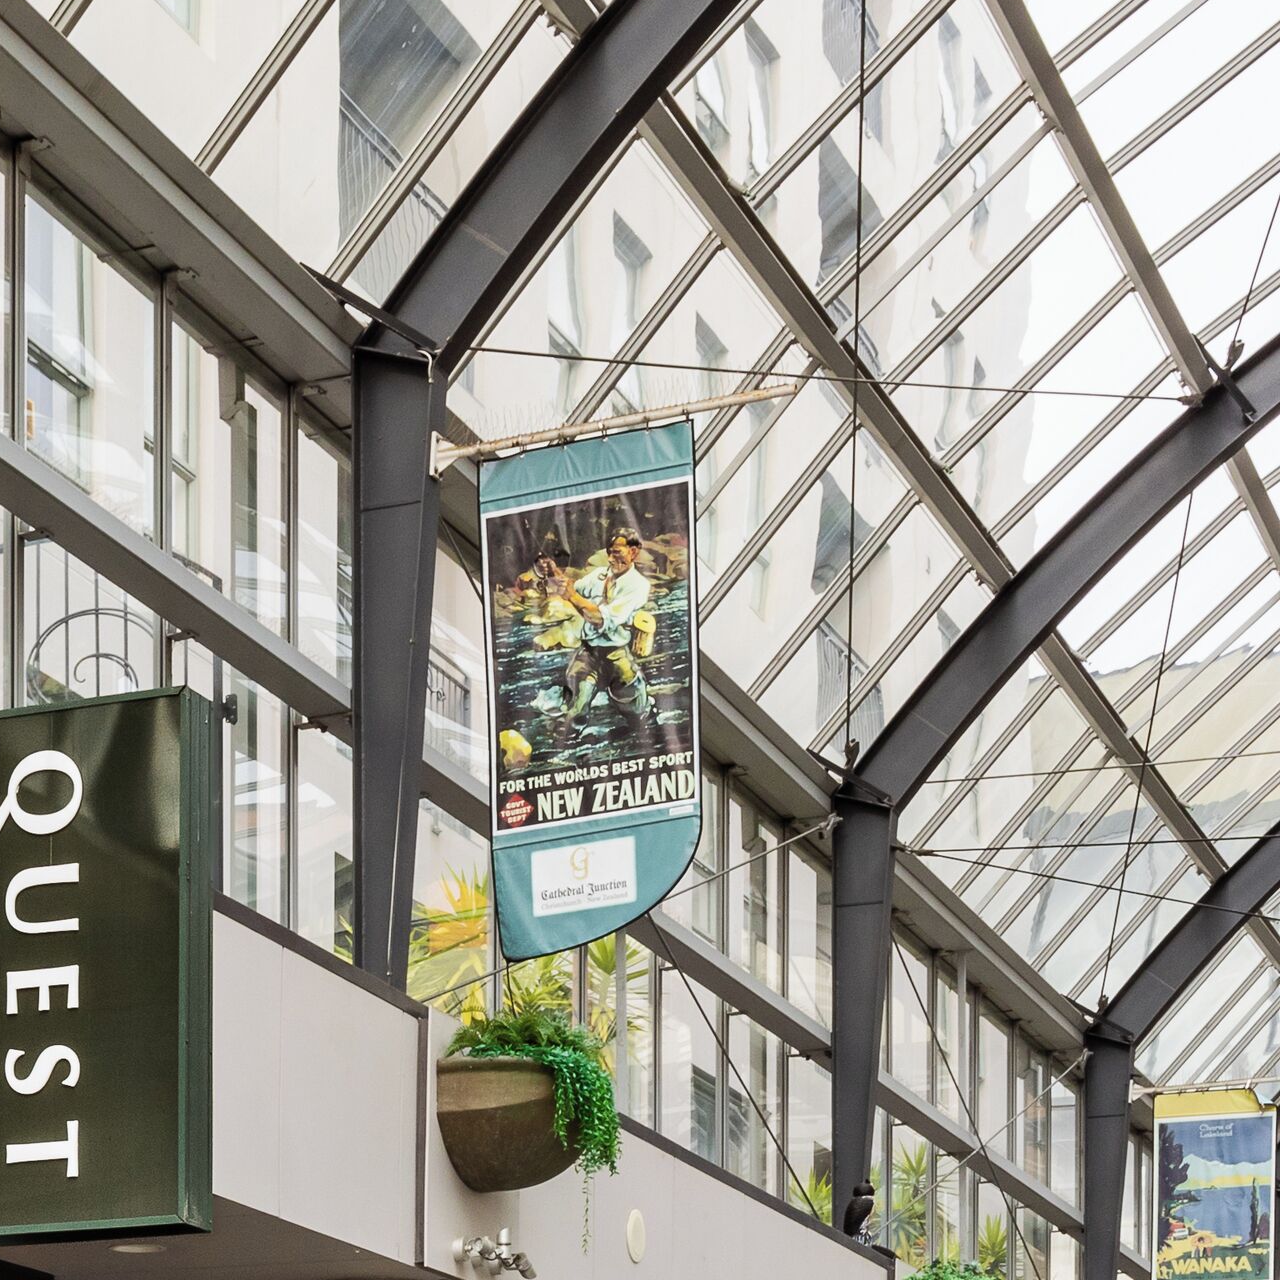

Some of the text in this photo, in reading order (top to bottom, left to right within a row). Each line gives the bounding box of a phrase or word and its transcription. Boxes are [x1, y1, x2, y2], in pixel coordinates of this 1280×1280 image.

[499, 750, 693, 794] FOR THE WORLDS BEST SPORT
[506, 800, 525, 809] GOVT
[536, 770, 695, 822] NEW ZEALAND
[507, 814, 527, 824] DEPT
[540, 879, 627, 901] Cathedral Junction
[1170, 1255, 1252, 1275] WANAKA
